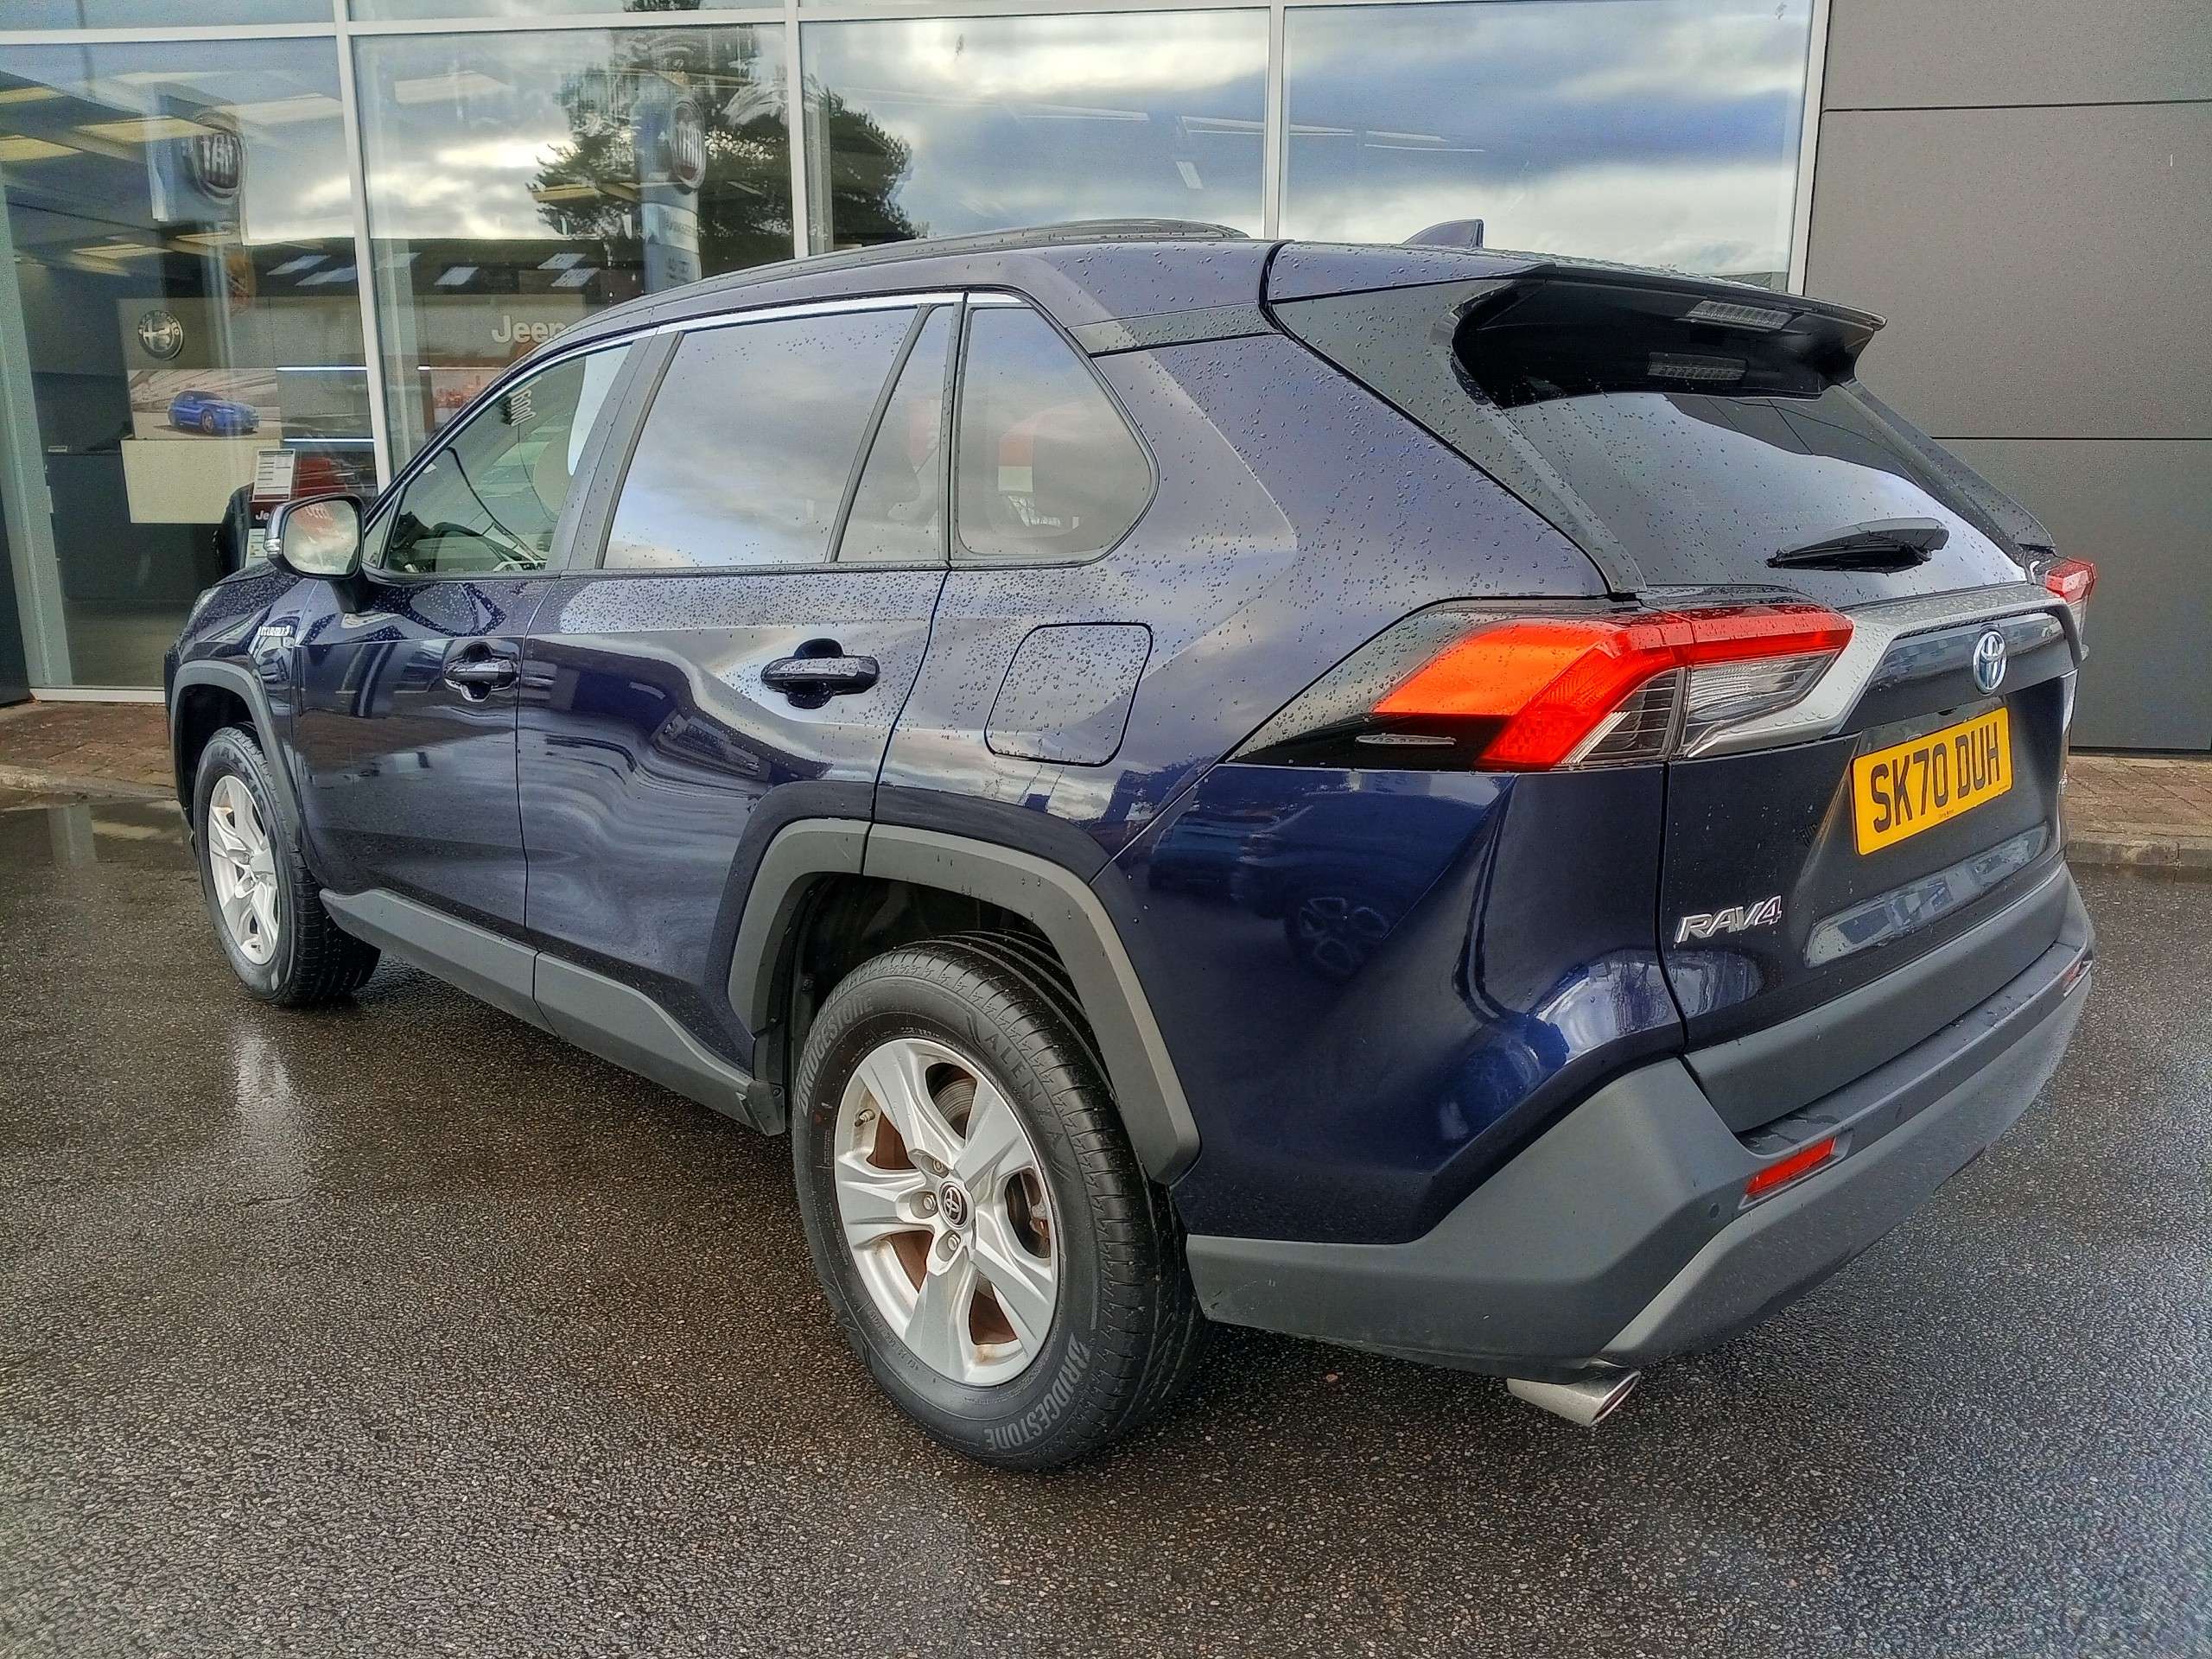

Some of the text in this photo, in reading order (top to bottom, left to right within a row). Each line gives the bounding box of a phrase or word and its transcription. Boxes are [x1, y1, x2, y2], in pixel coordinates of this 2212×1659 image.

[1870, 721, 2000, 833] SK70 DUH
[1674, 895, 1782, 944] RAV4
[984, 1033, 1064, 1150] ALENZA
[983, 1332, 1090, 1452] BRIDGESTONE
